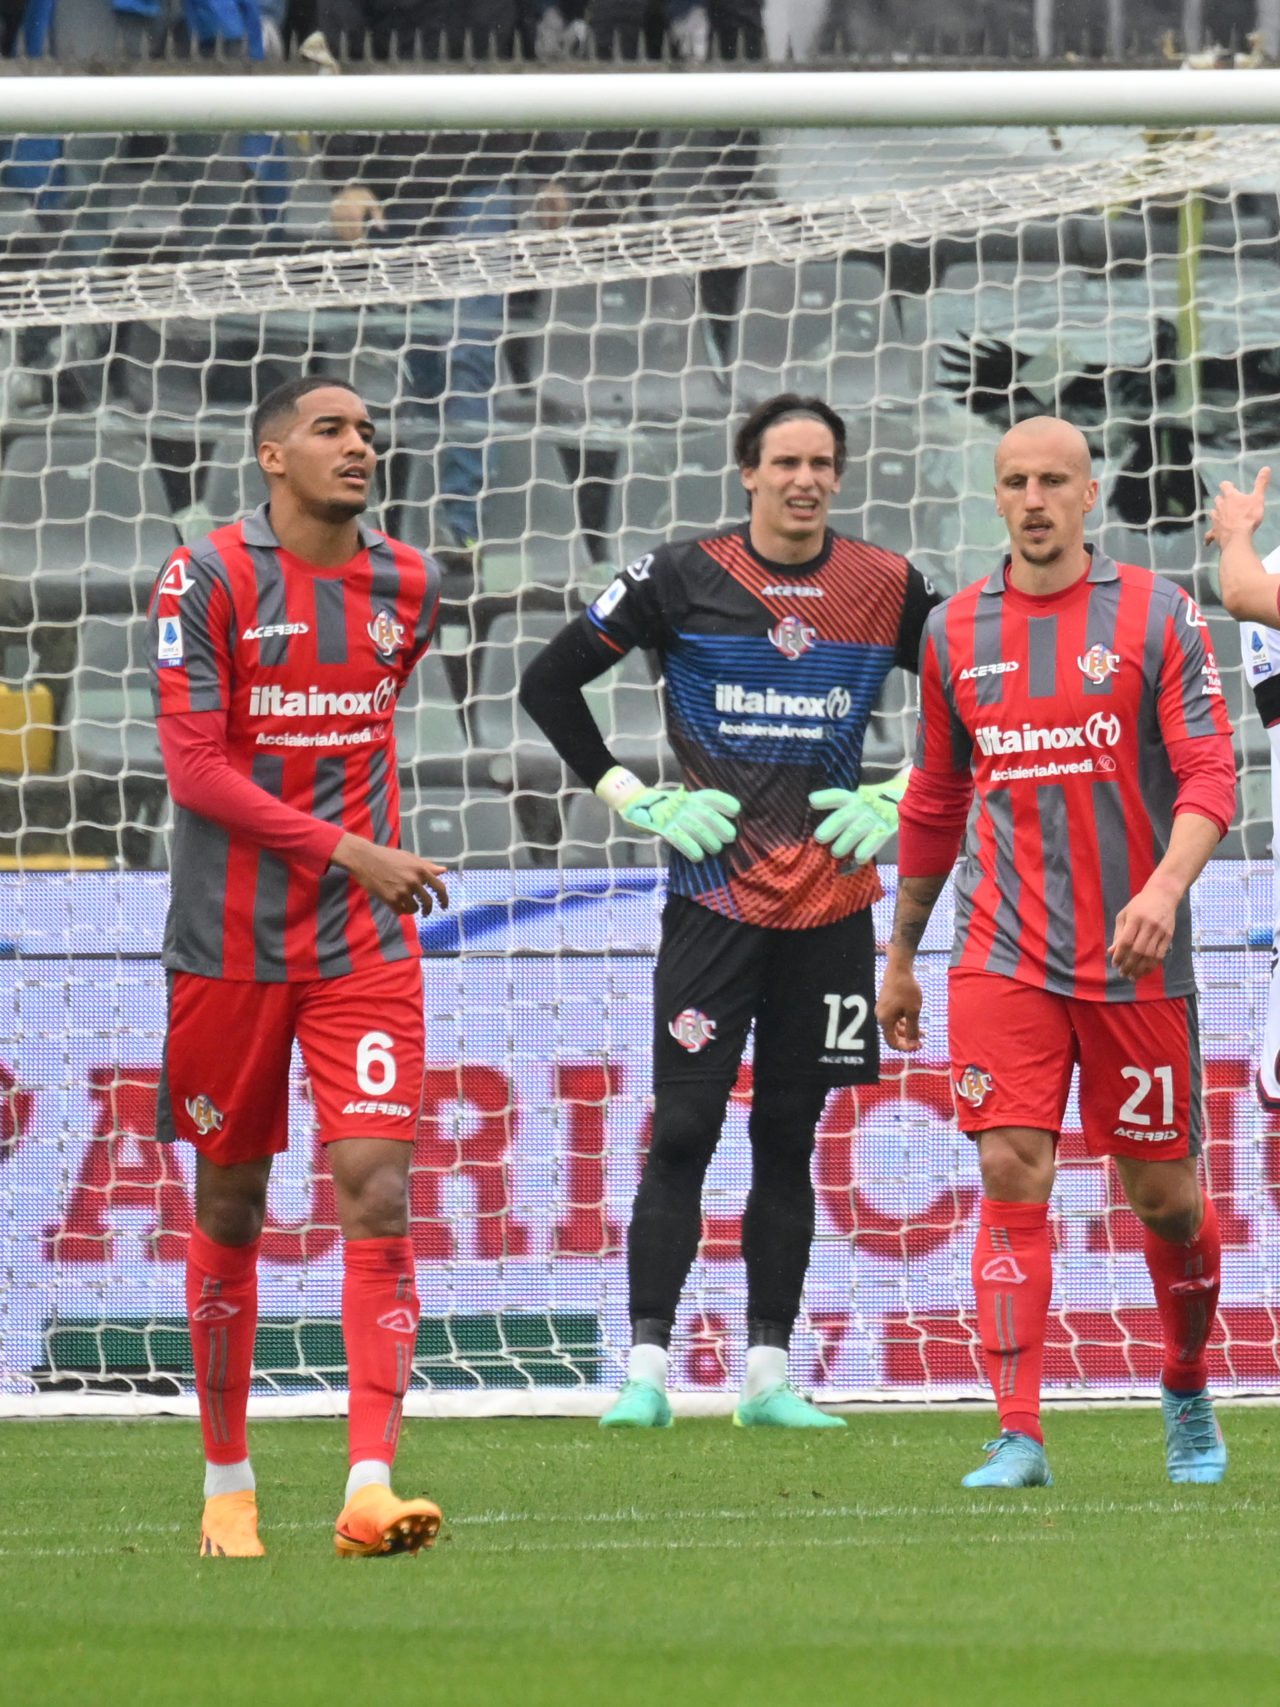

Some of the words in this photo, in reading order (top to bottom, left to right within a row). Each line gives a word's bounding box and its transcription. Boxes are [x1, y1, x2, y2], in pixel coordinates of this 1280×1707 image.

[761, 586, 824, 598] ACERBIS
[242, 622, 309, 640] ACERBIS
[959, 661, 1020, 681] ACERBIS
[249, 685, 373, 717] iltainox
[715, 684, 828, 719] iltainox
[255, 726, 372, 748] AcciaieriaArvedi
[975, 723, 1087, 757] iltainox
[823, 993, 869, 1051] 12
[355, 1030, 397, 1096] 6
[342, 1101, 412, 1117] ACERBIS
[1118, 1065, 1175, 1126] 21
[1113, 1127, 1179, 1142] ACERBIS
